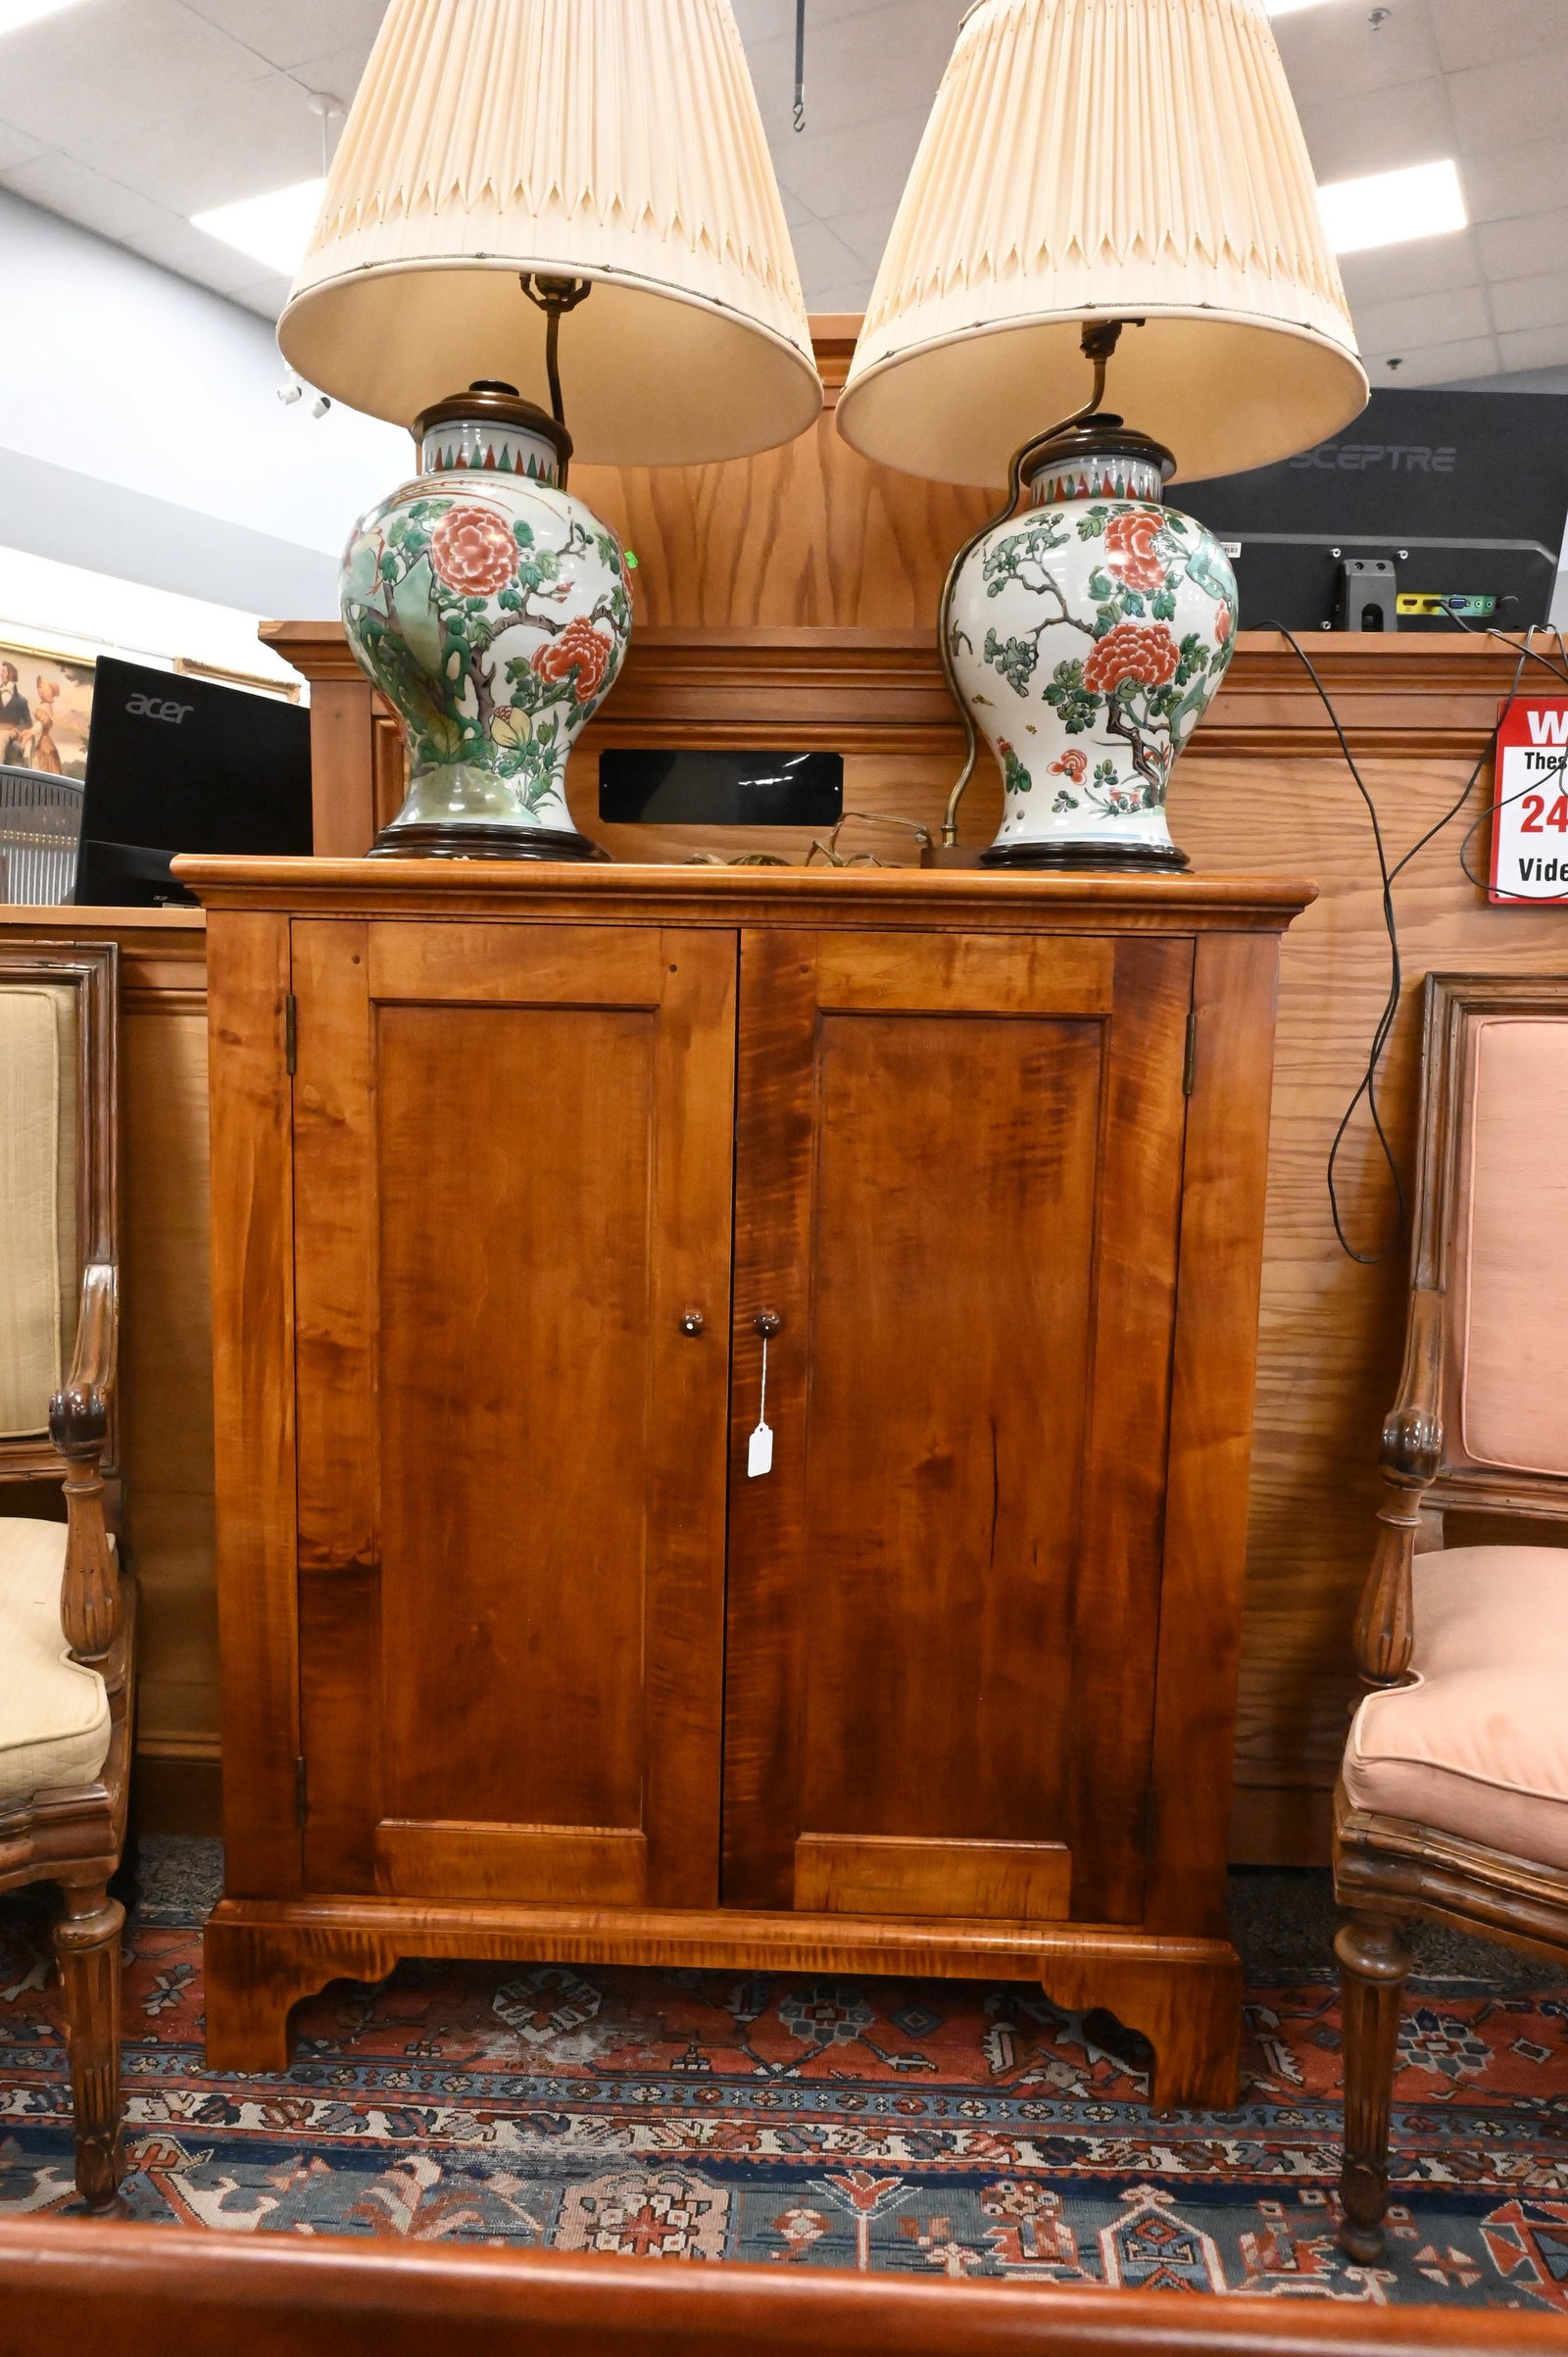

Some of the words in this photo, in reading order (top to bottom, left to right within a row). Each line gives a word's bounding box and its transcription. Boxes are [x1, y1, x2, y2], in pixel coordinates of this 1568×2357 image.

[125, 692, 194, 724] acer
[1520, 795, 1568, 832] 24
[1518, 858, 1568, 882] Vide
